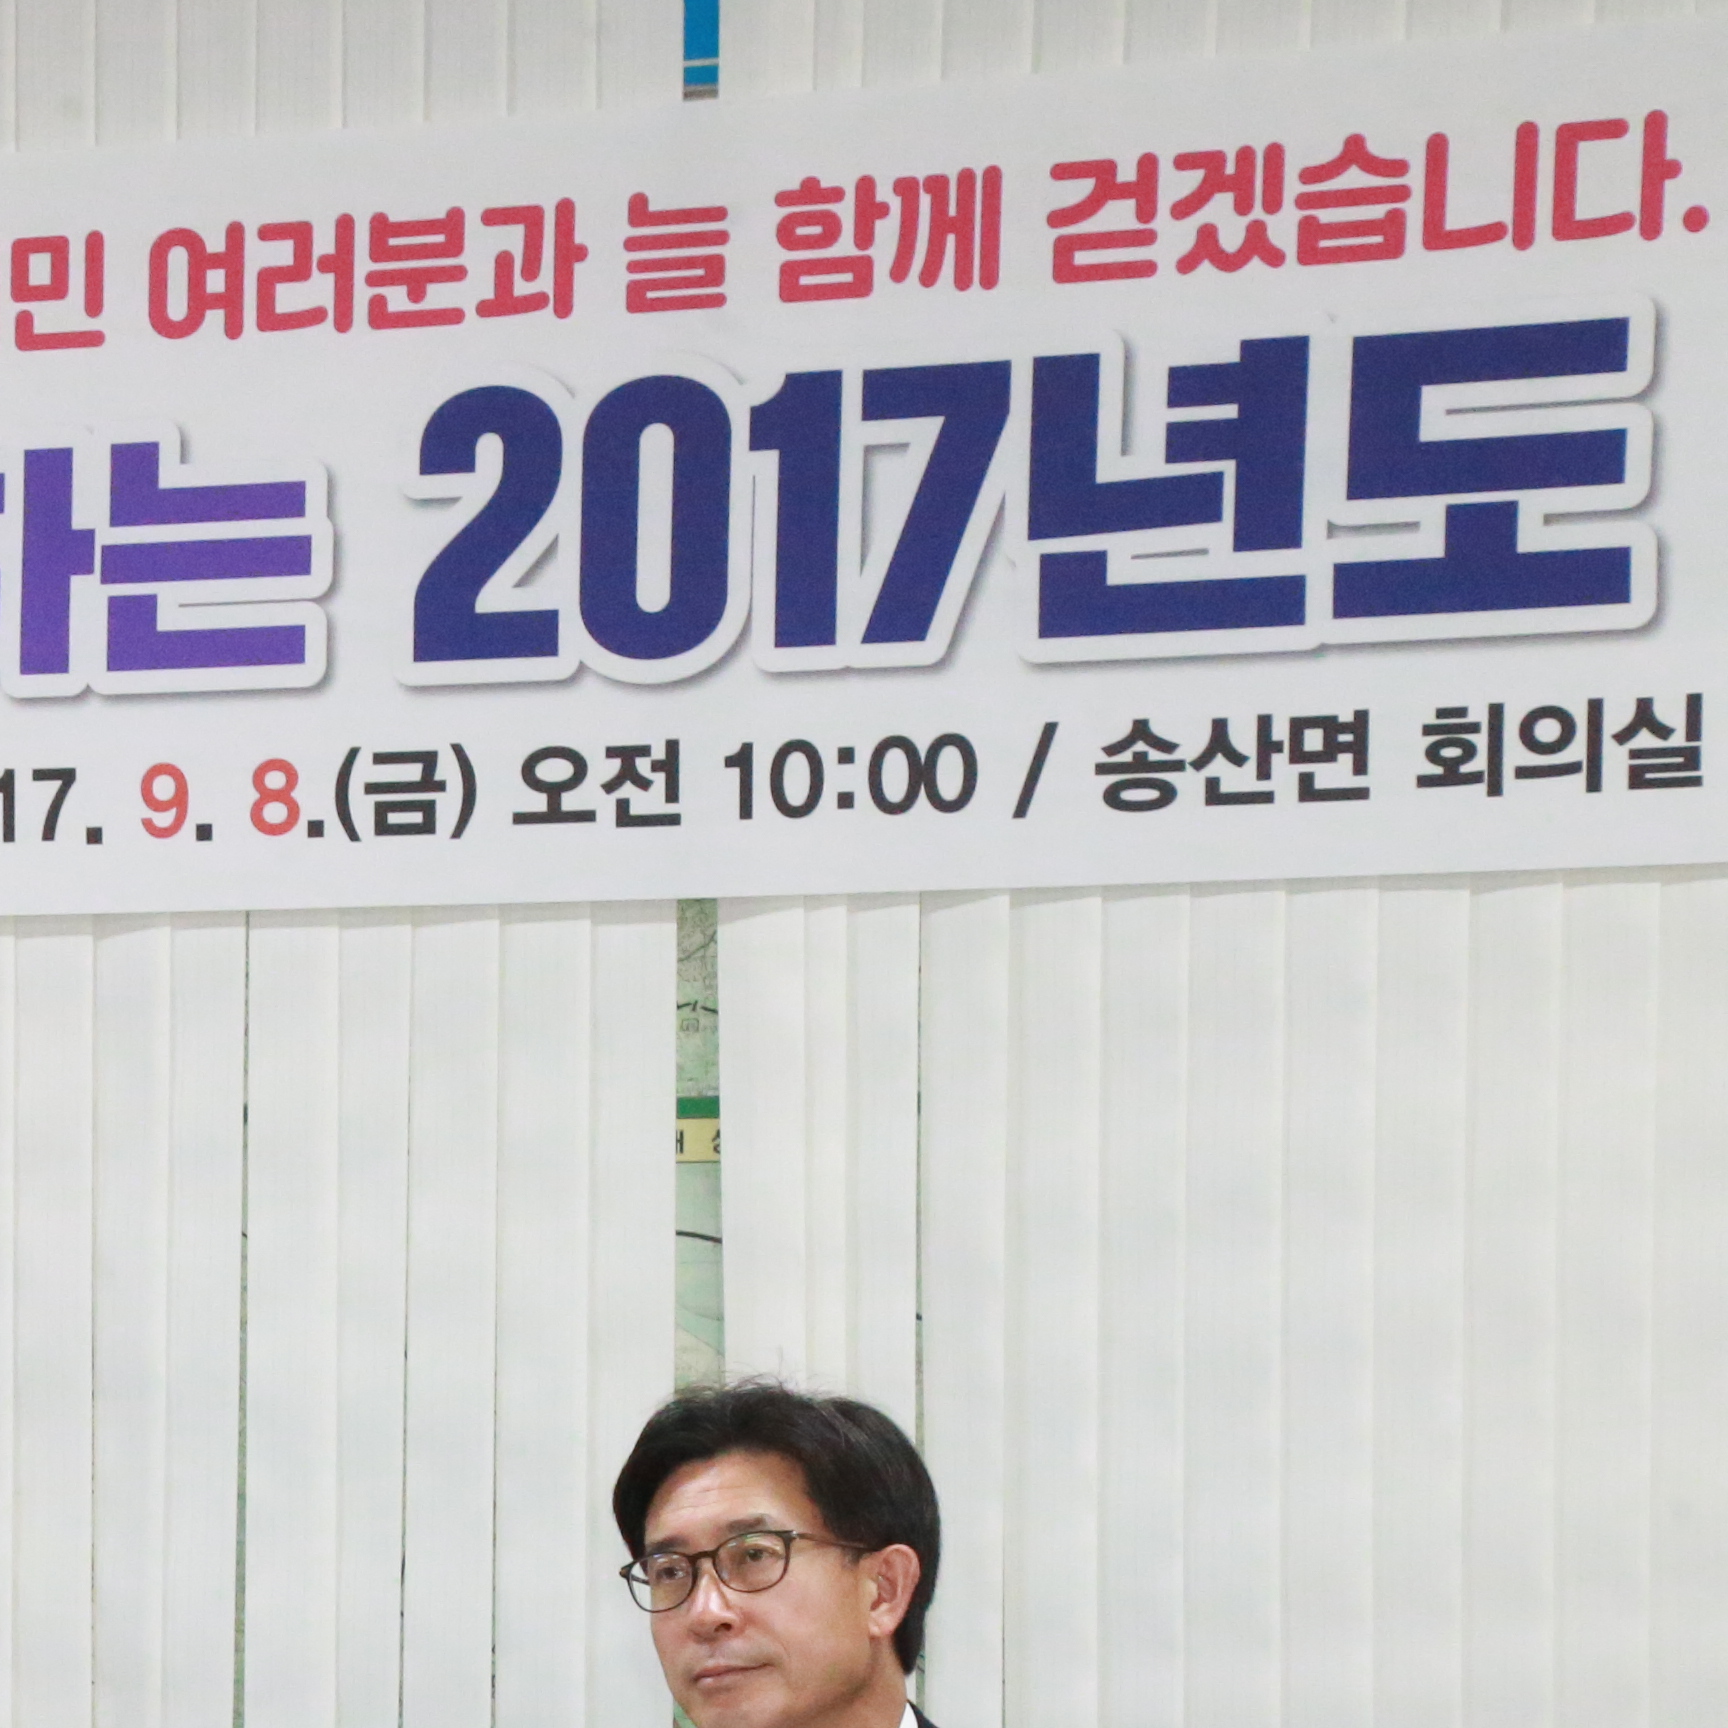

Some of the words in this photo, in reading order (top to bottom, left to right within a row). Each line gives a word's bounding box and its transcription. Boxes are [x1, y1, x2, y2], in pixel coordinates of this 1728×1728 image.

[148, 197, 589, 340] 여러분과
[623, 192, 731, 314] 늘
[773, 164, 1003, 304] 함께
[1046, 109, 1710, 285] 걷겠습니다.
[411, 316, 1632, 663] 2017년도
[139, 762, 214, 842] 9.
[511, 738, 683, 828] 오전
[723, 733, 979, 820] 10:00
[1012, 721, 1059, 819] /
[1093, 708, 1371, 813] 송산면
[1415, 692, 1704, 797] 회의실
